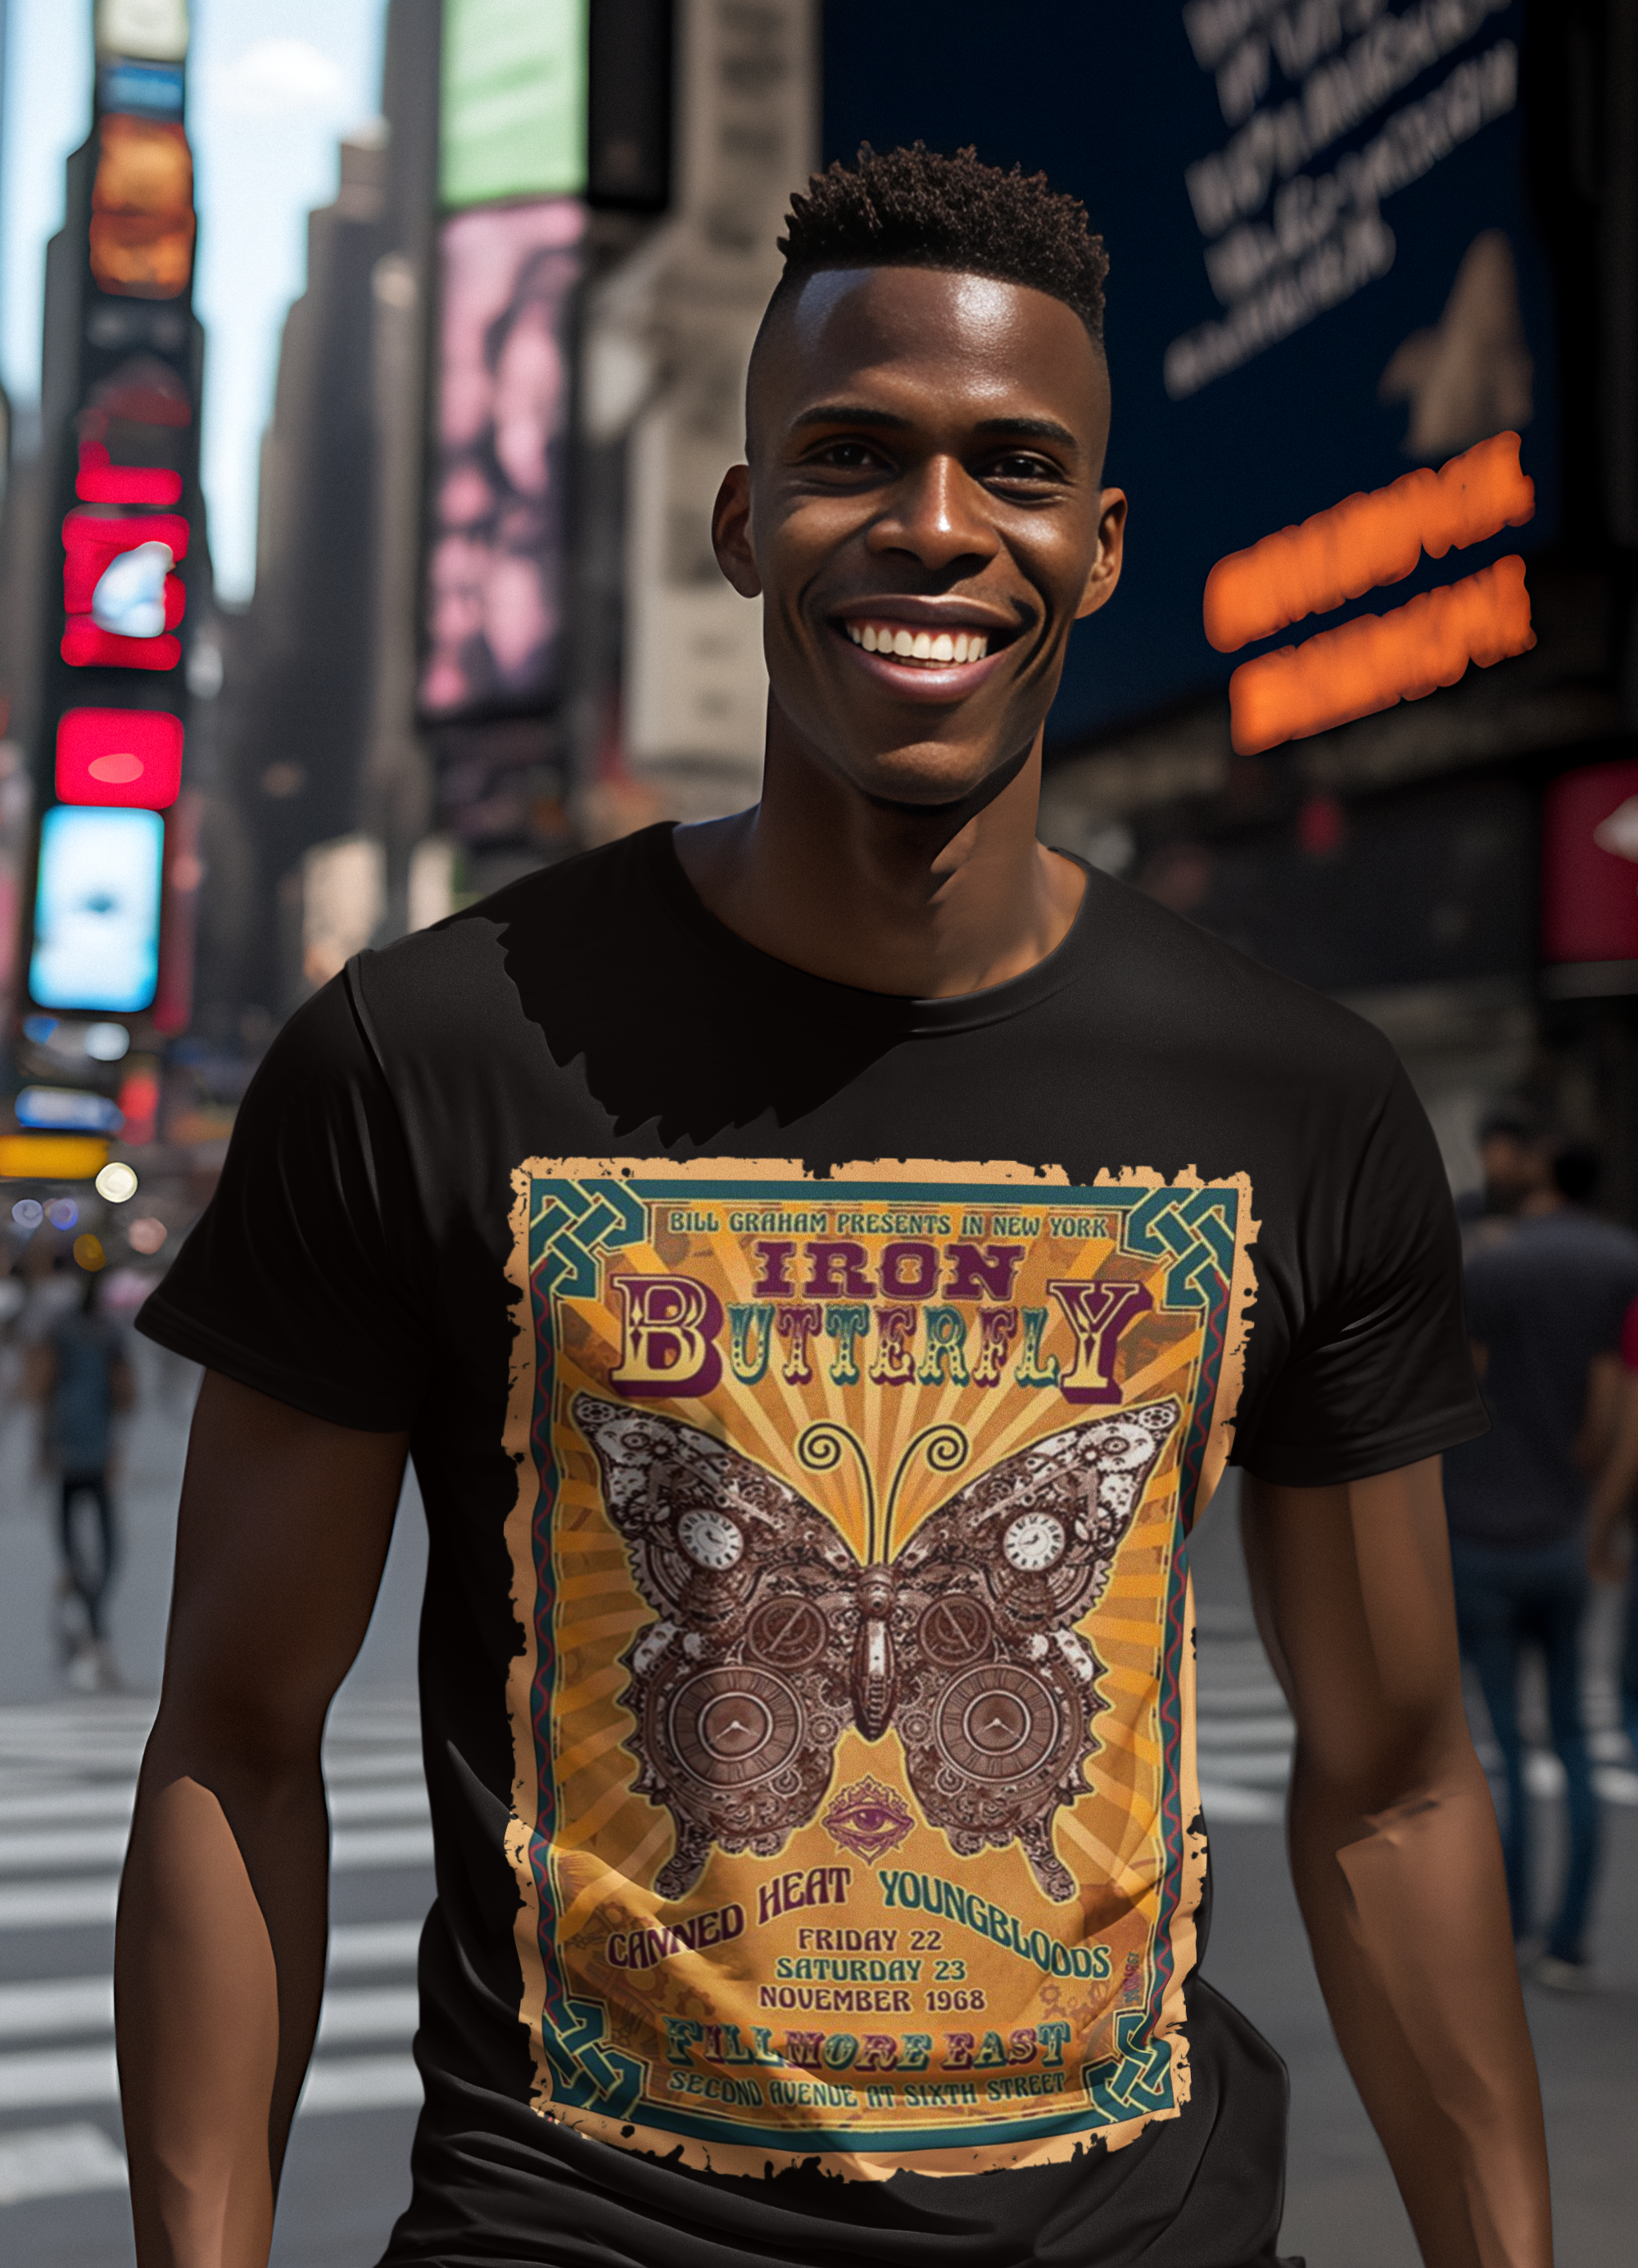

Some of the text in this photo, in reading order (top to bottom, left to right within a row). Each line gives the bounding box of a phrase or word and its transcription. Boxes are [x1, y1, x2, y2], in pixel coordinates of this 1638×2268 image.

[668, 1211, 1107, 1238] BILL GRAHAM PRESENTS IN NEW YORK
[753, 1240, 1025, 1301] IRON
[609, 1274, 1153, 1405] BUTTERFLY
[606, 1867, 851, 1969] CANNED HEAT
[798, 1928, 943, 1952] FRIDAY 22
[878, 1870, 1111, 1979] YOUNGBLOODS
[776, 1957, 966, 1981] SATURDAY 23
[759, 1986, 986, 2013] NOVEMBER 1968
[660, 2015, 1072, 2072] FILLMORE EAST
[667, 2070, 1066, 2108] SECOND AVENUE AT SIXTH STREET
